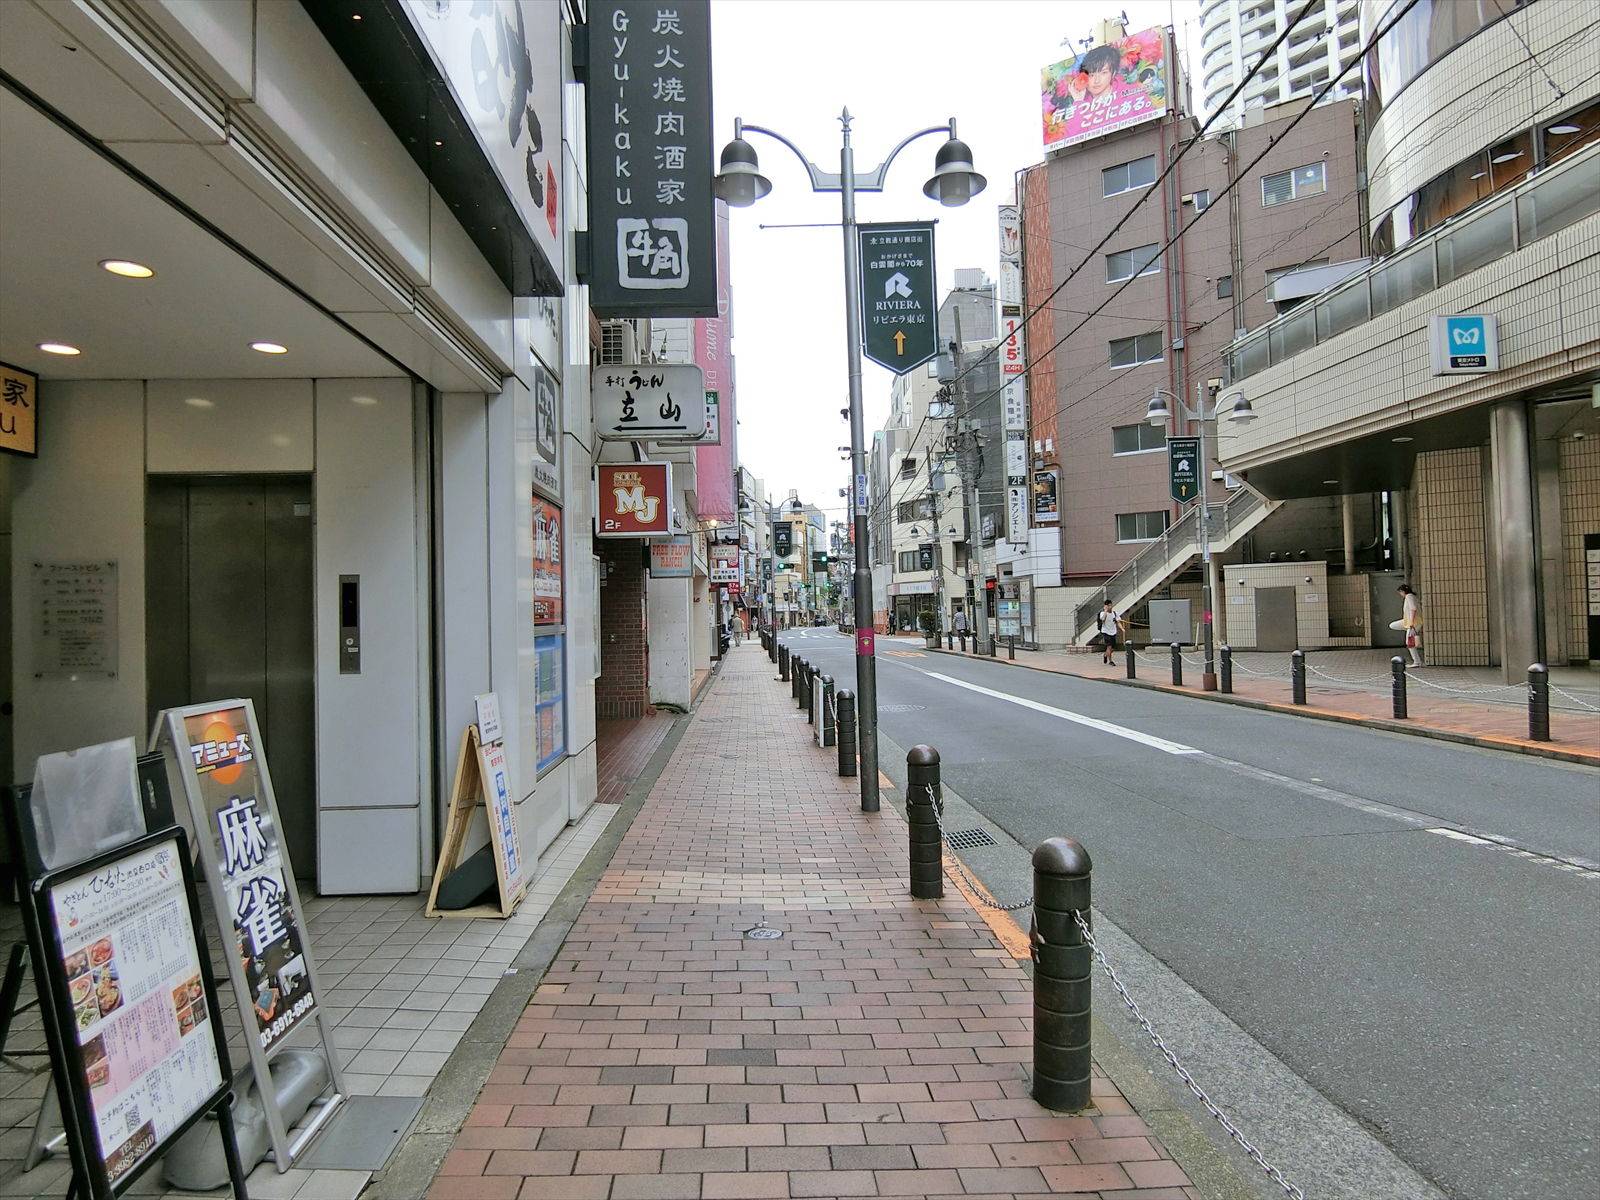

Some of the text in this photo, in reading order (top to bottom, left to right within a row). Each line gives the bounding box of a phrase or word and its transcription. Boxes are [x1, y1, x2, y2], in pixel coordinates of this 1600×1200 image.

[612, 9, 632, 205] Gyu-kaku
[652, 9, 686, 205] 炭火焼肉酒家
[879, 236, 923, 244] 立教通り商店街
[627, 229, 681, 276] 牛角
[876, 300, 921, 311] RIVIERA
[873, 314, 925, 324] リビエラ東京
[605, 369, 664, 391] 手打うどん
[619, 390, 682, 423] 立山
[1011, 477, 1023, 485] 2F
[612, 485, 660, 523] MJ
[604, 519, 622, 530] 2F
[652, 544, 691, 556] FREE FLOW
[660, 556, 683, 568] RANCH
[190, 733, 251, 765] アミューズ
[215, 796, 288, 957] 麻雀
[260, 992, 315, 1049] 03-6912-6848
[119, 1139, 135, 1156] TEL
